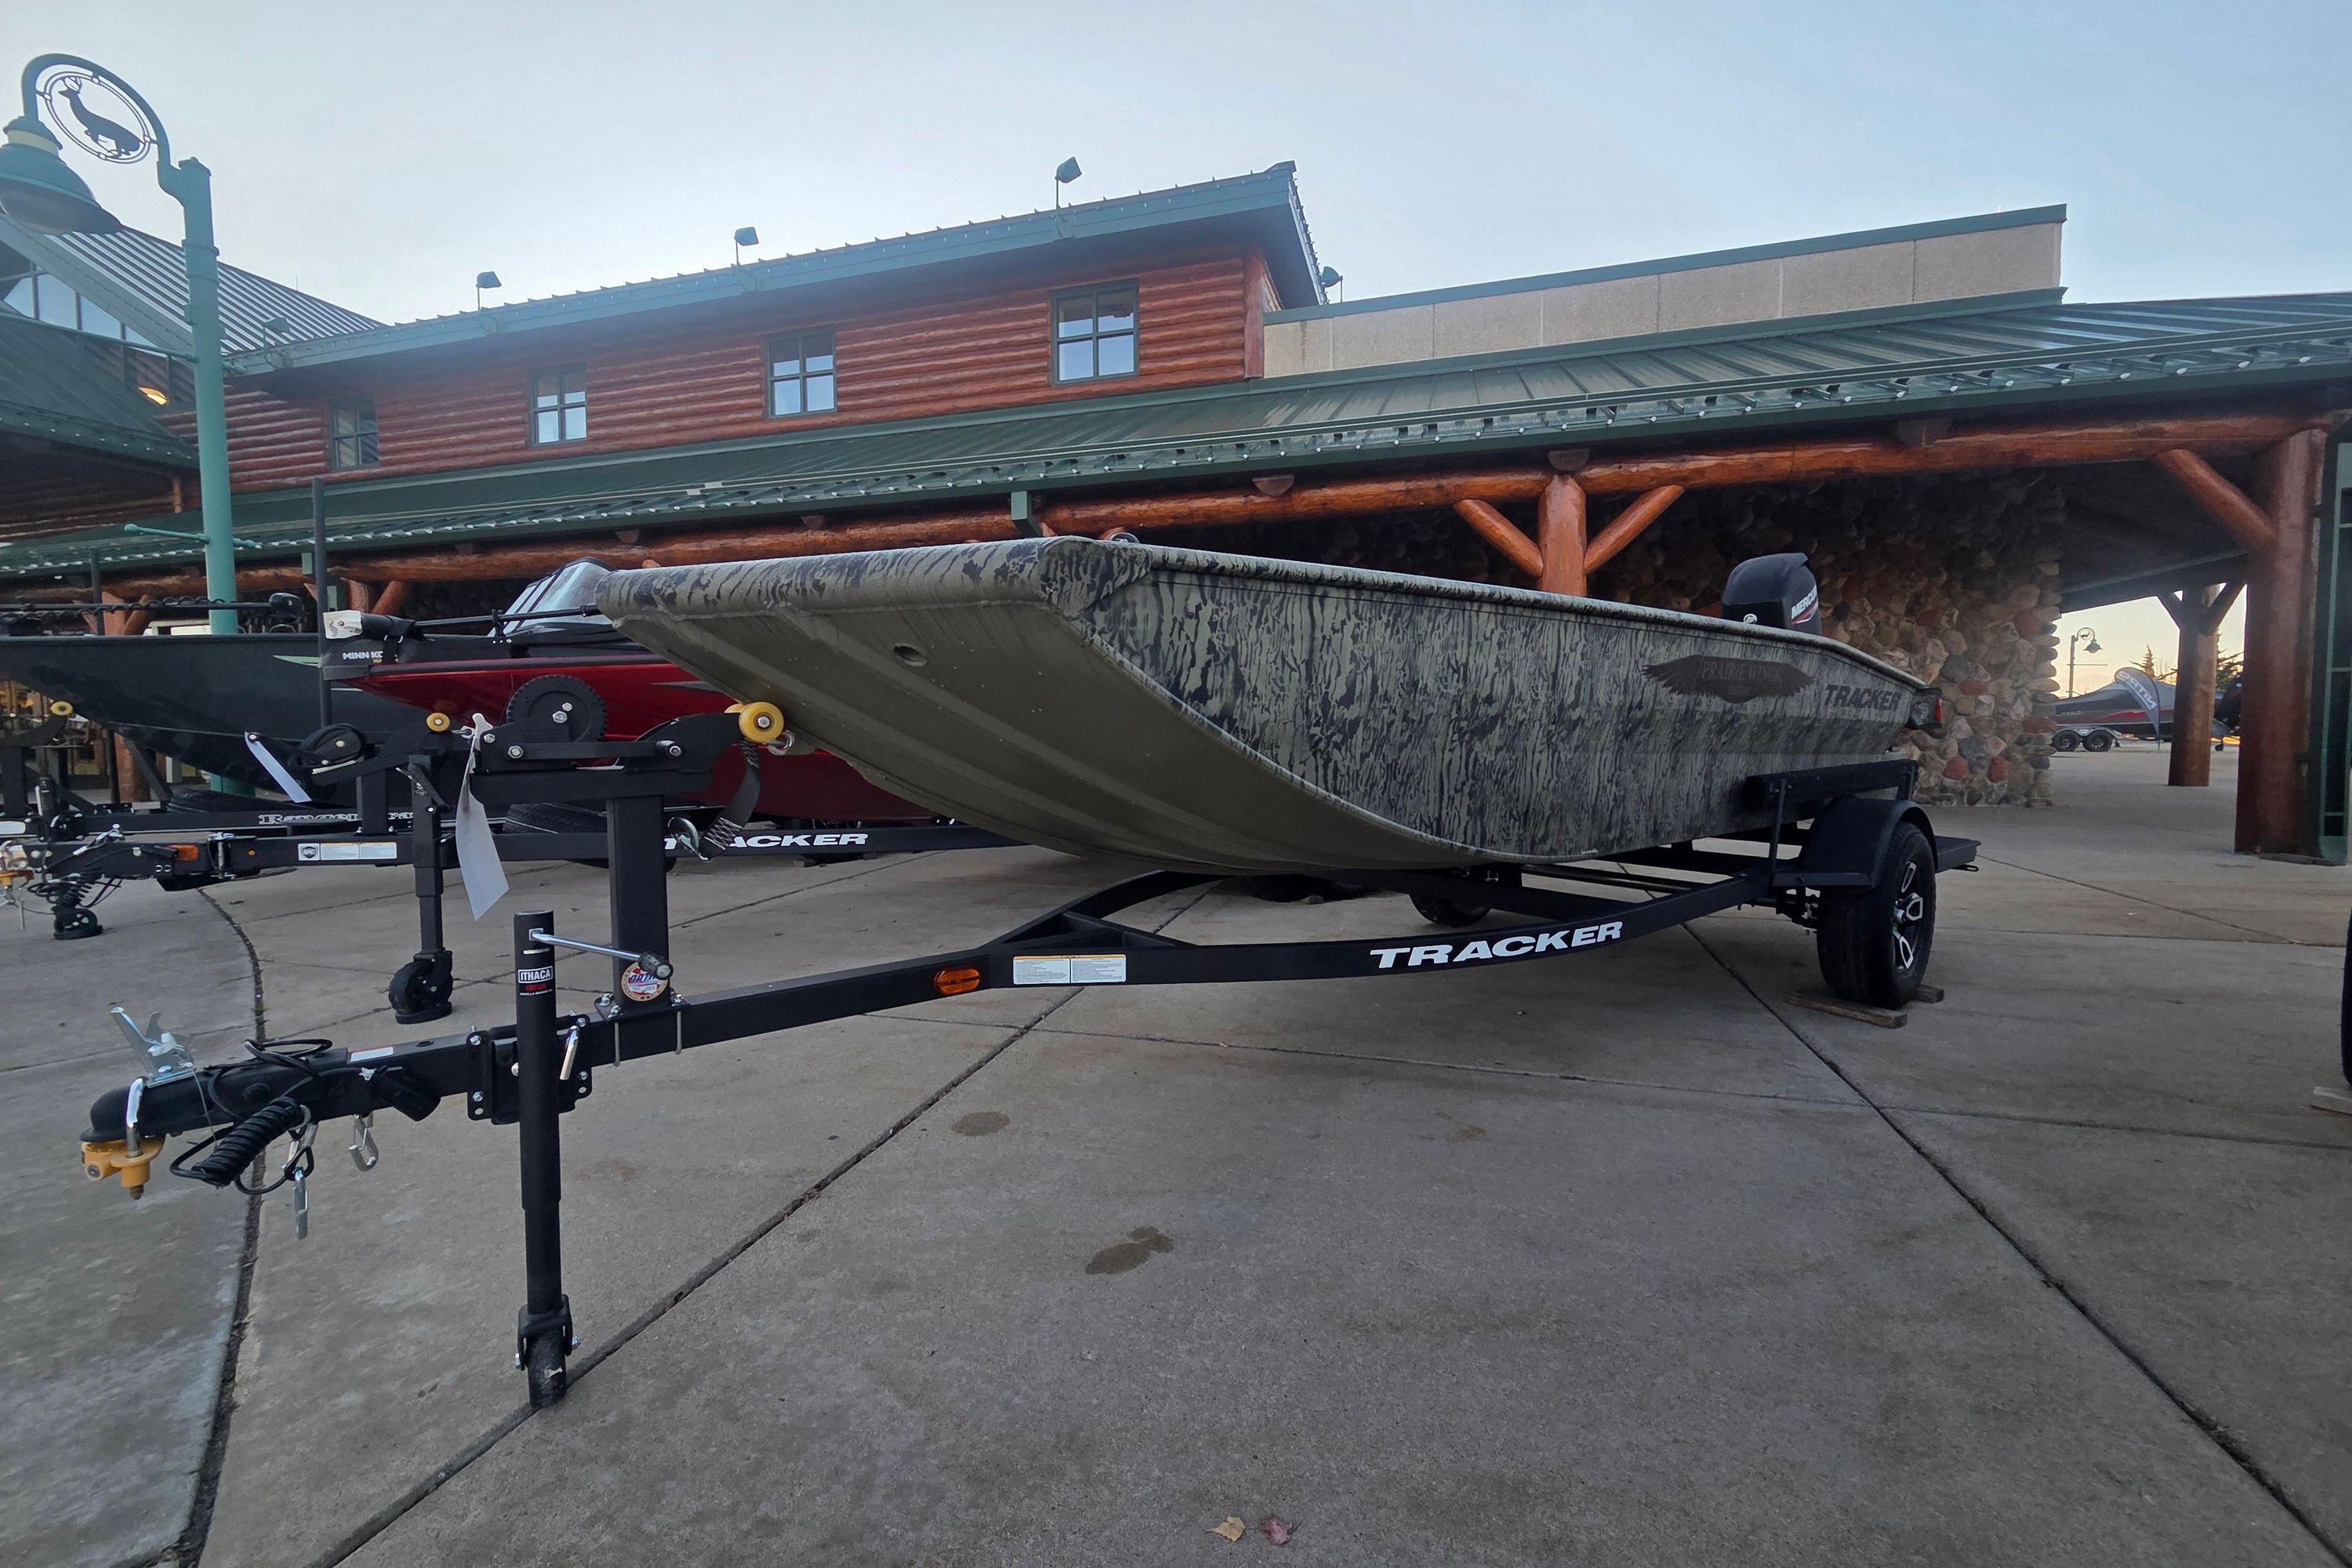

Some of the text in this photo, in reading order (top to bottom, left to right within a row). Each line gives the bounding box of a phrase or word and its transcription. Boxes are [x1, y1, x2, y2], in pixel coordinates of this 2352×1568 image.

[1824, 684, 1902, 712] TRACKER
[664, 833, 869, 849] TACKER
[1370, 921, 1623, 968] TRACKER
[521, 969, 551, 981] ITHACA
